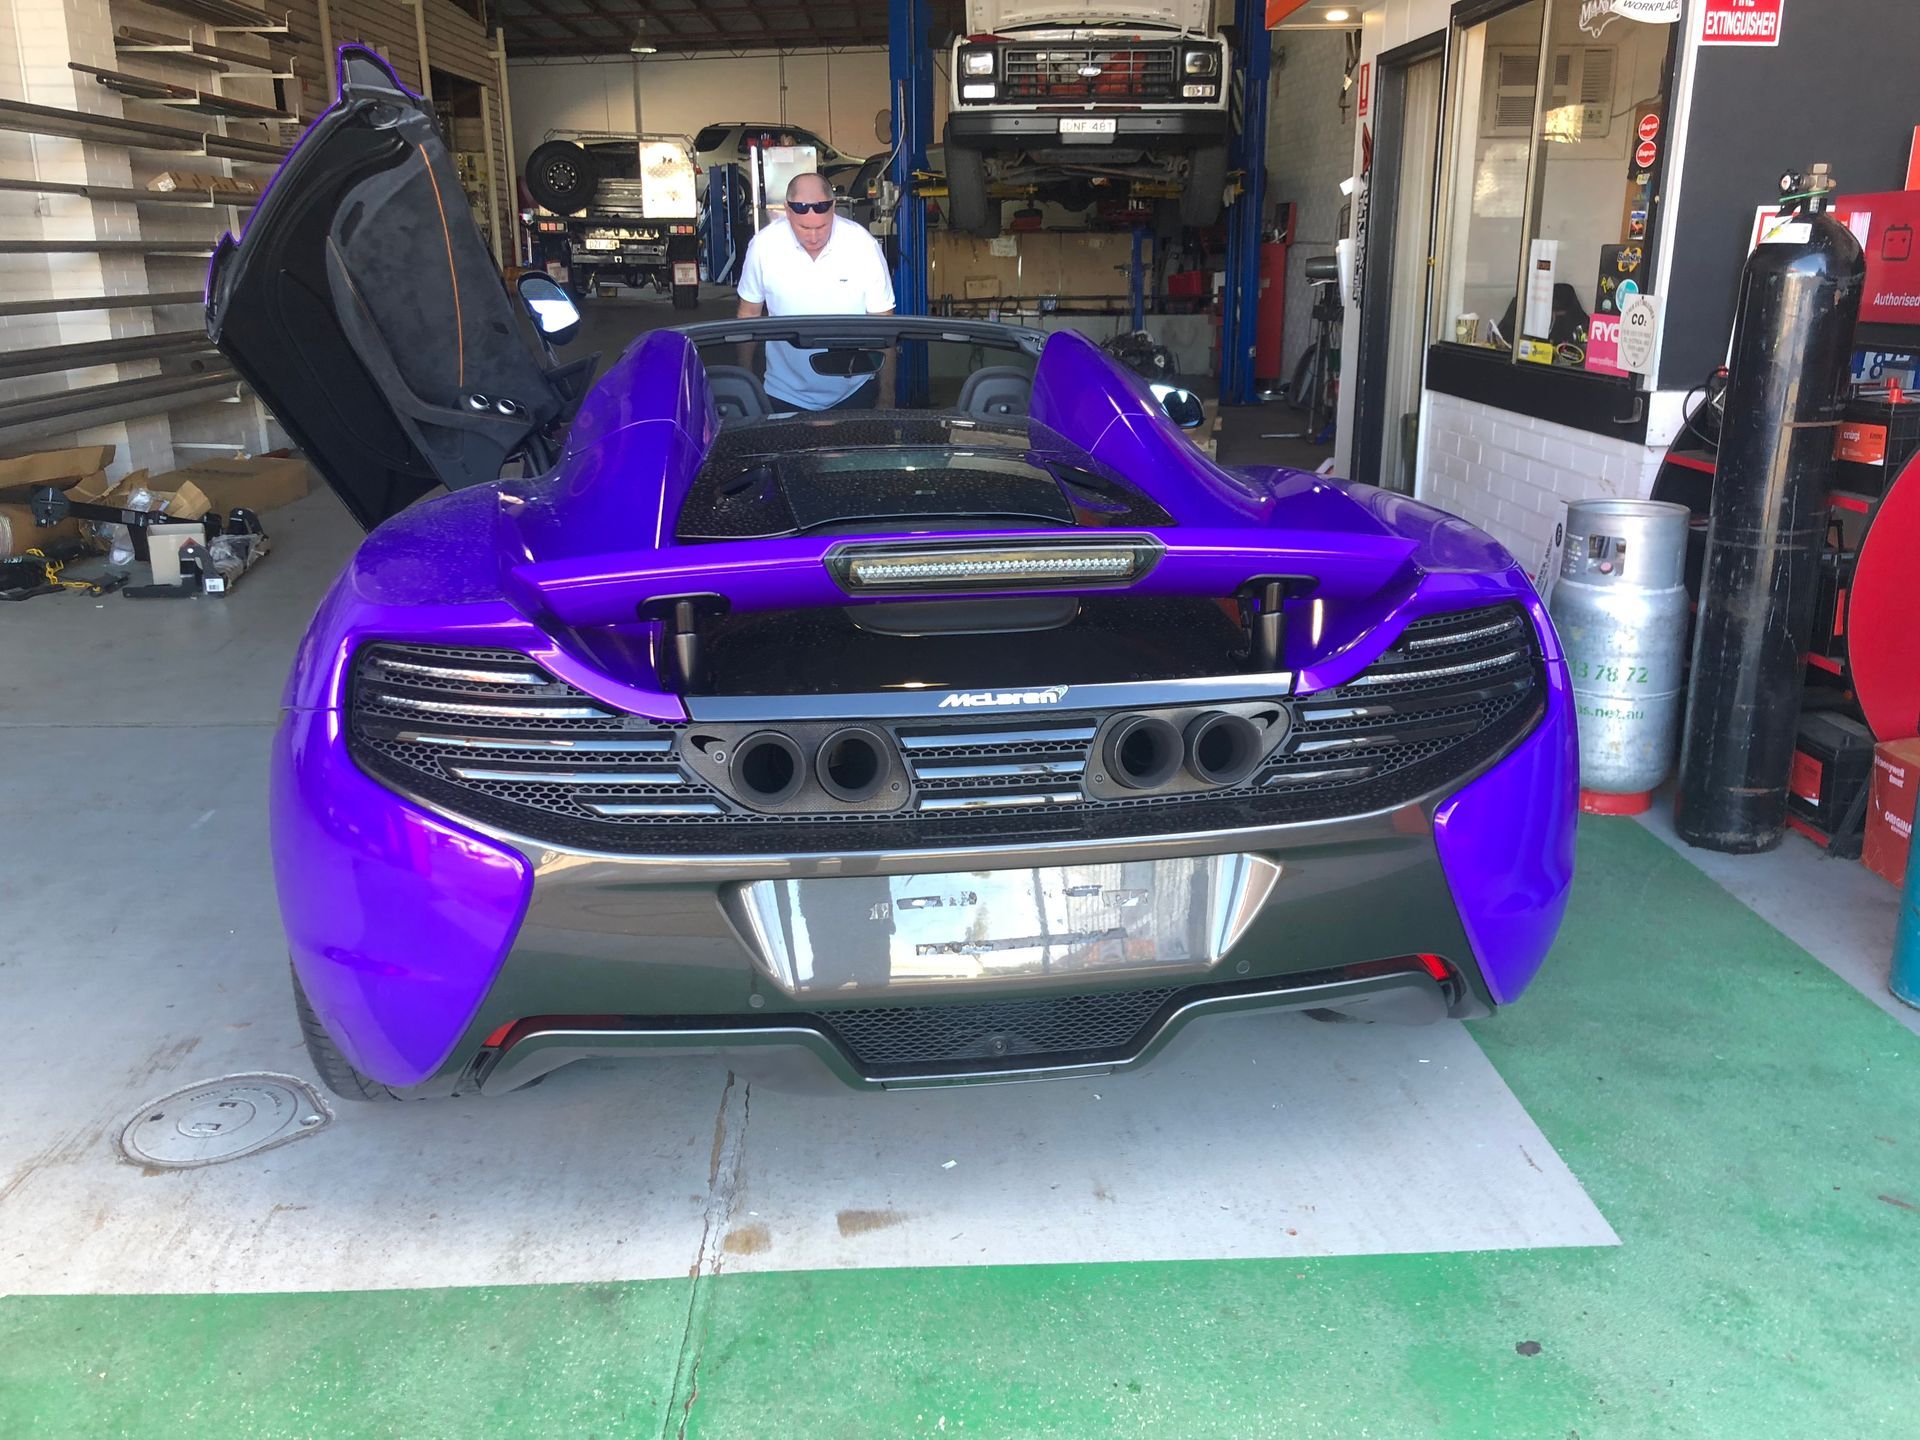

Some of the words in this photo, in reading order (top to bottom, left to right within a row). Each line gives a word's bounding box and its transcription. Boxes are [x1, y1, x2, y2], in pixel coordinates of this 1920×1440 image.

[1623, 0, 1679, 11] WORKPLACE
[1705, 11, 1777, 36] EXTINGUISHER
[1595, 664, 1619, 682] 78
[1626, 667, 1648, 683] 72
[938, 691, 1059, 708] McLaren
